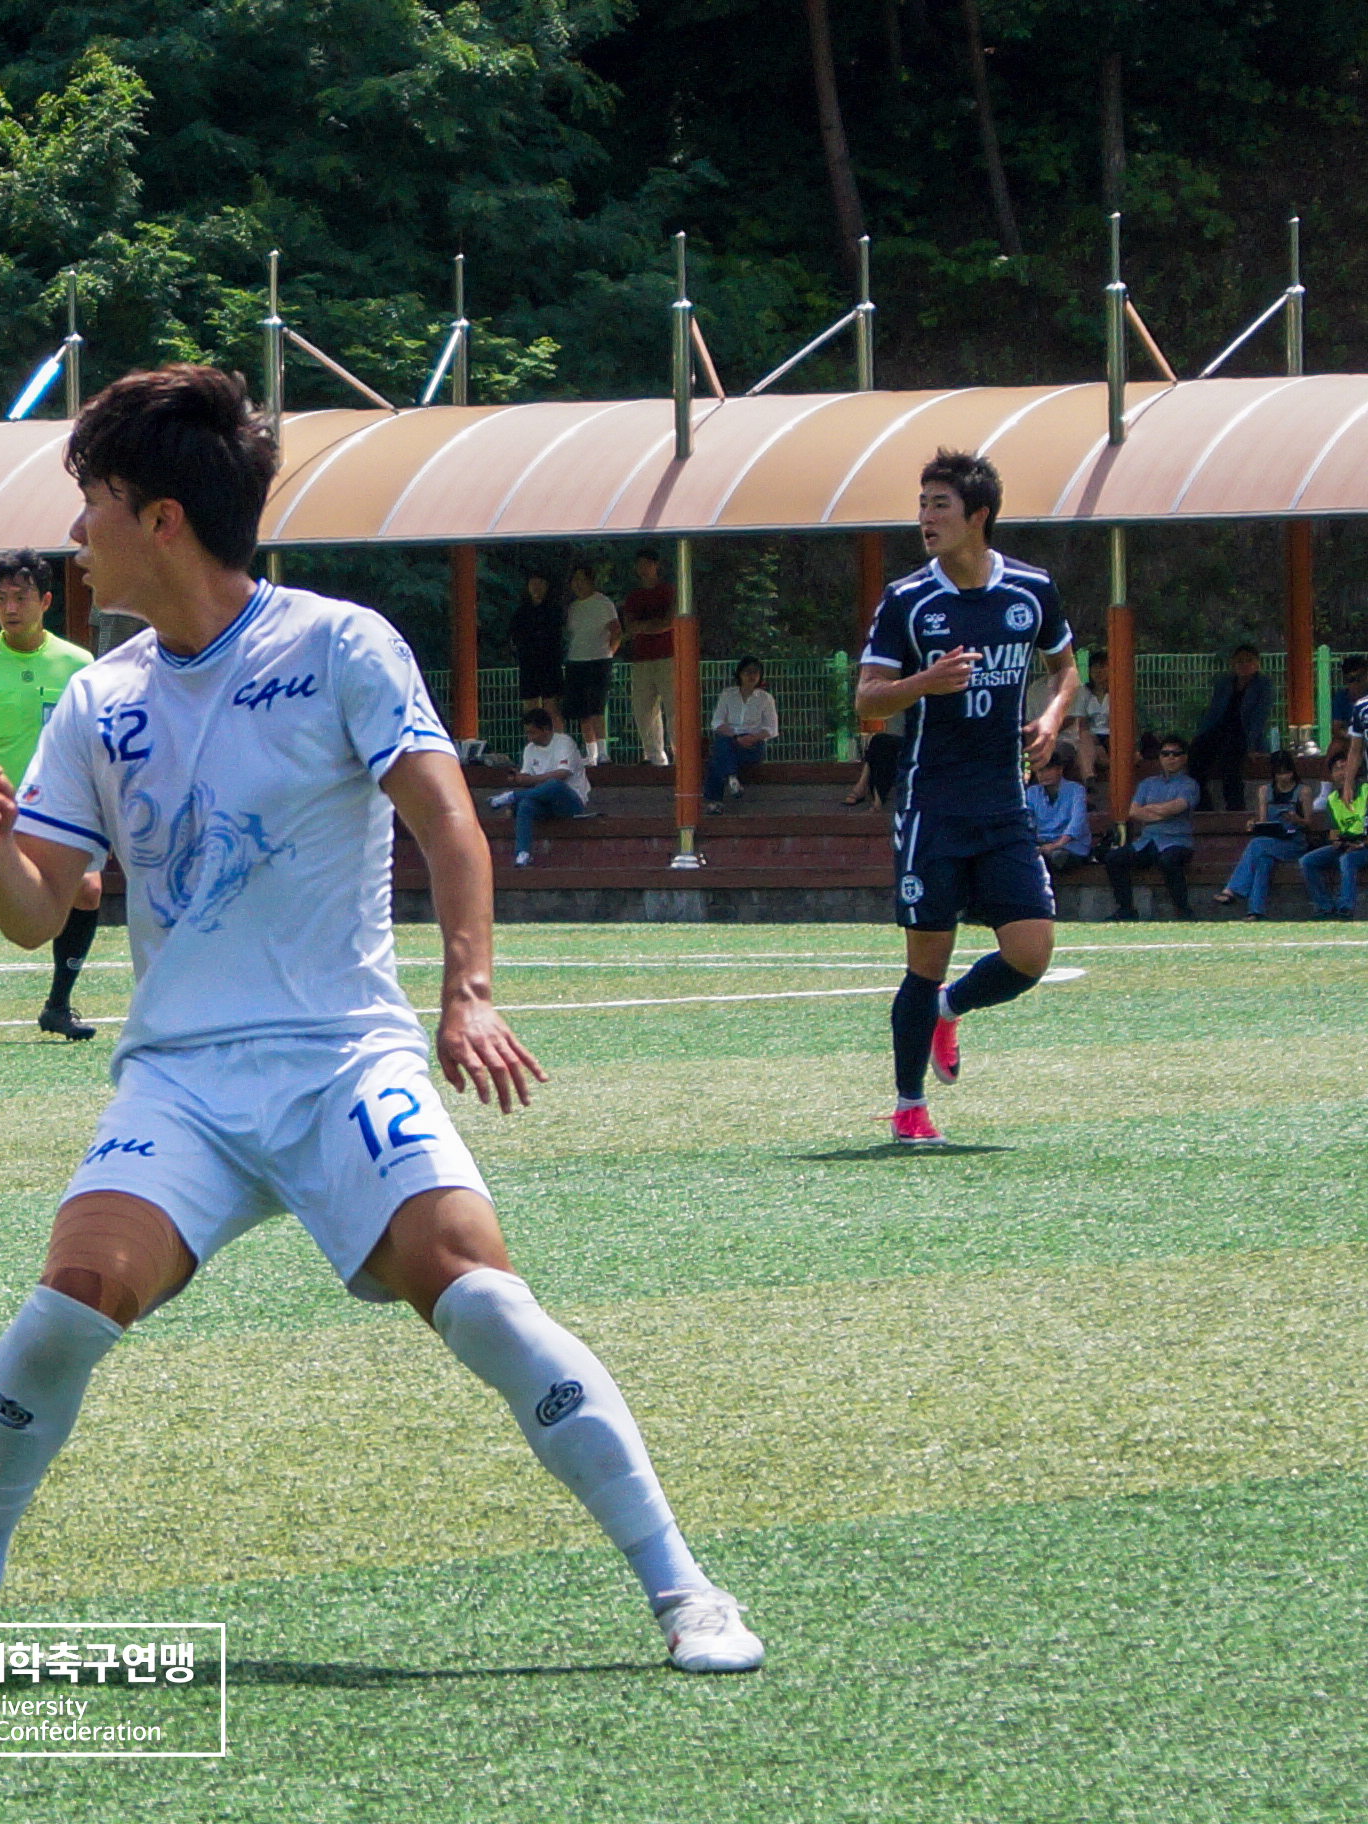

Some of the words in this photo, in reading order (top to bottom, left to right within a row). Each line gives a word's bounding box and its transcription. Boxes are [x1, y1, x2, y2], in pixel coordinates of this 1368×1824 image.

[965, 689, 992, 717] 10
[97, 710, 150, 764] 12
[347, 1087, 438, 1163] 12
